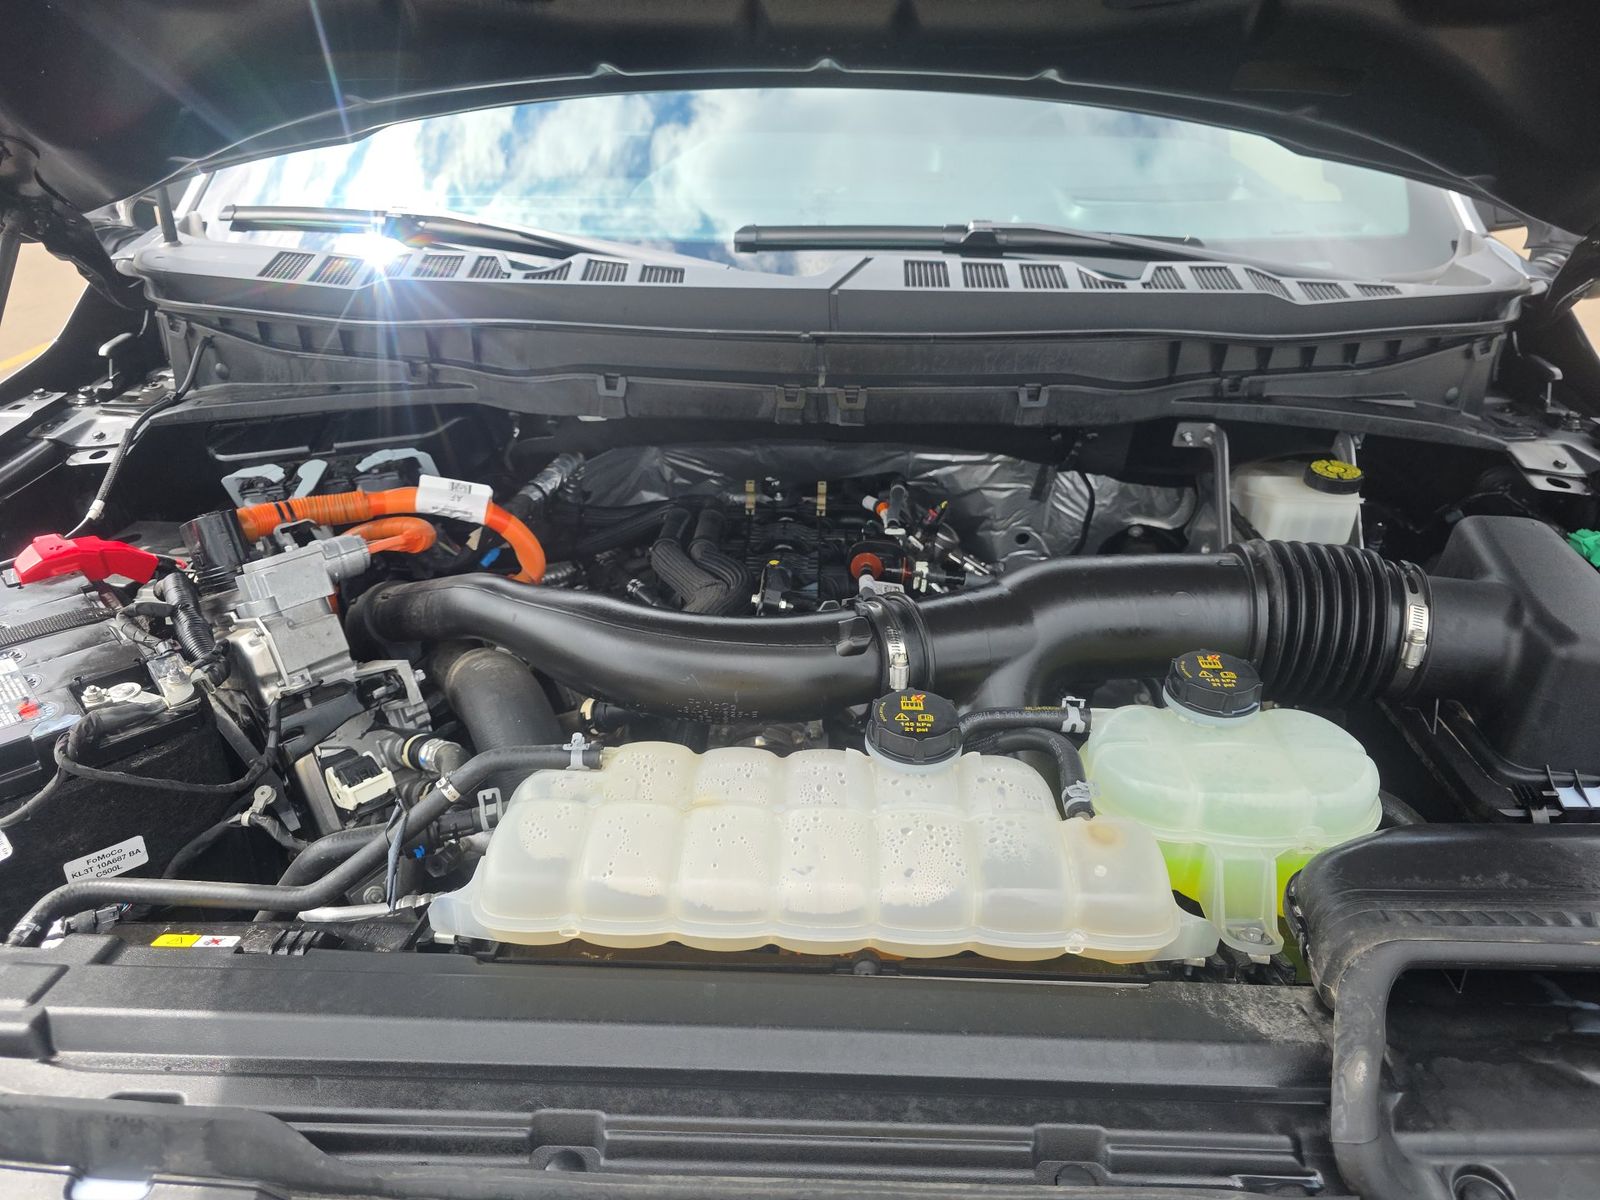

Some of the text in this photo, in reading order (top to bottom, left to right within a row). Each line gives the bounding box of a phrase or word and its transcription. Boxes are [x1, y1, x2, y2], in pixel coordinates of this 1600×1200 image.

[71, 848, 142, 879] KL3T 10A687 BA
[86, 848, 123, 866] FoMoCo
[95, 864, 123, 878] C500L
